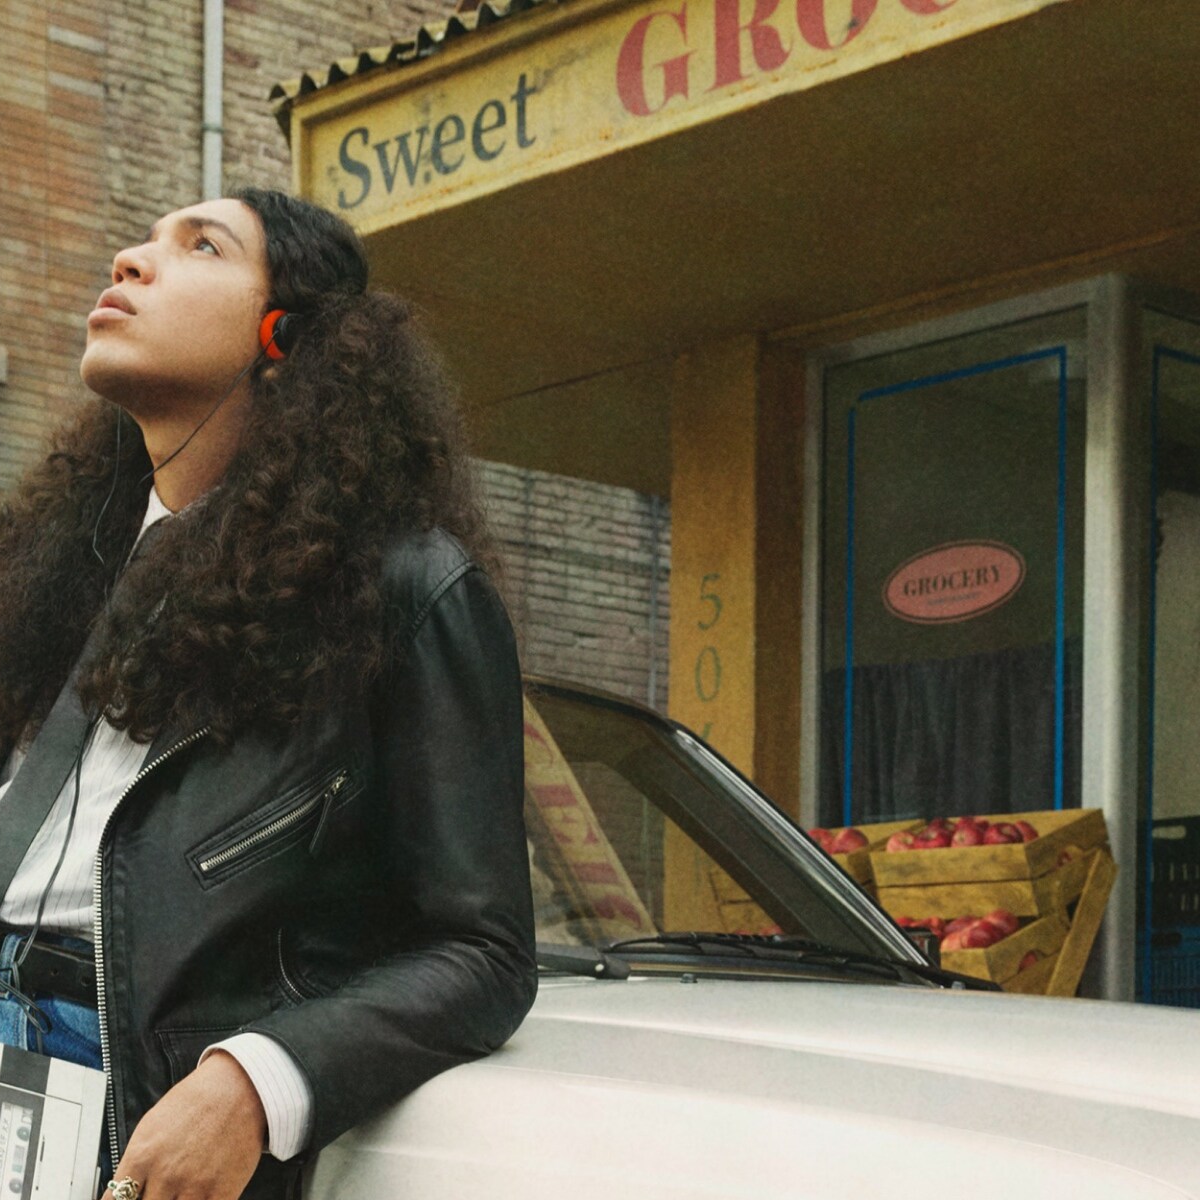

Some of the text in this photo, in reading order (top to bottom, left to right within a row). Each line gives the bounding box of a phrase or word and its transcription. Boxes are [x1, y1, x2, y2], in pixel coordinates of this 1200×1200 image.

[337, 0, 961, 210] Sweet GRO
[693, 572, 723, 741] 50
[902, 564, 1001, 597] GROCERY
